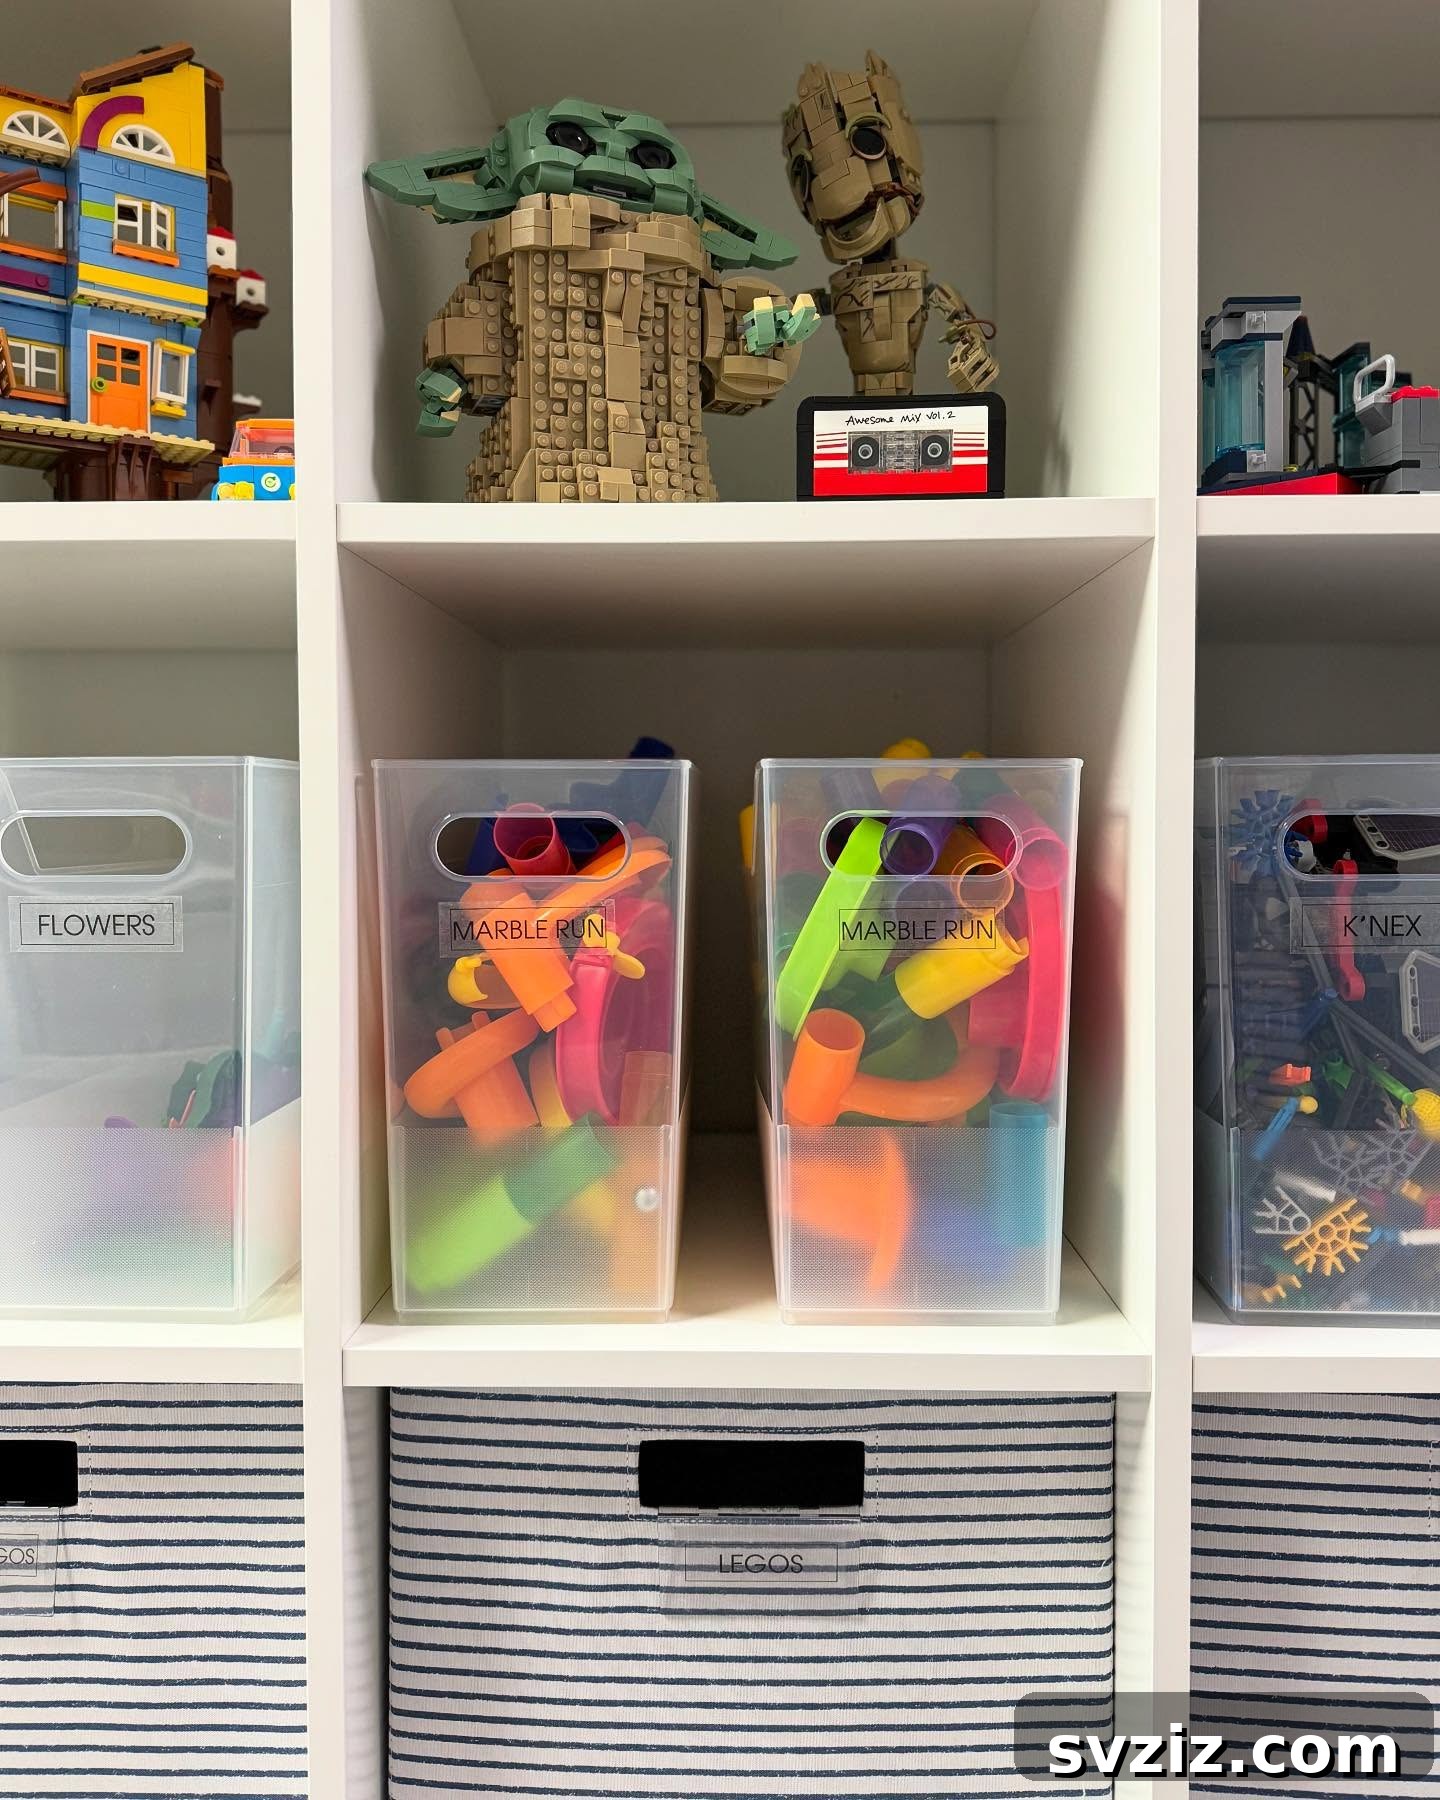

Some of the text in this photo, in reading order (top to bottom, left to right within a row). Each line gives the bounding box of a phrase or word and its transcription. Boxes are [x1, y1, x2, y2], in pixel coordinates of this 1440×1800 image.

[845, 415, 895, 426] Awesome
[947, 410, 956, 419] 2
[38, 914, 155, 936] FLOWERS
[453, 918, 604, 941] MARBLE RUN
[842, 919, 993, 941] MARBLE RUN
[1343, 914, 1422, 937] K'NEX
[719, 1554, 804, 1574] LEGOS
